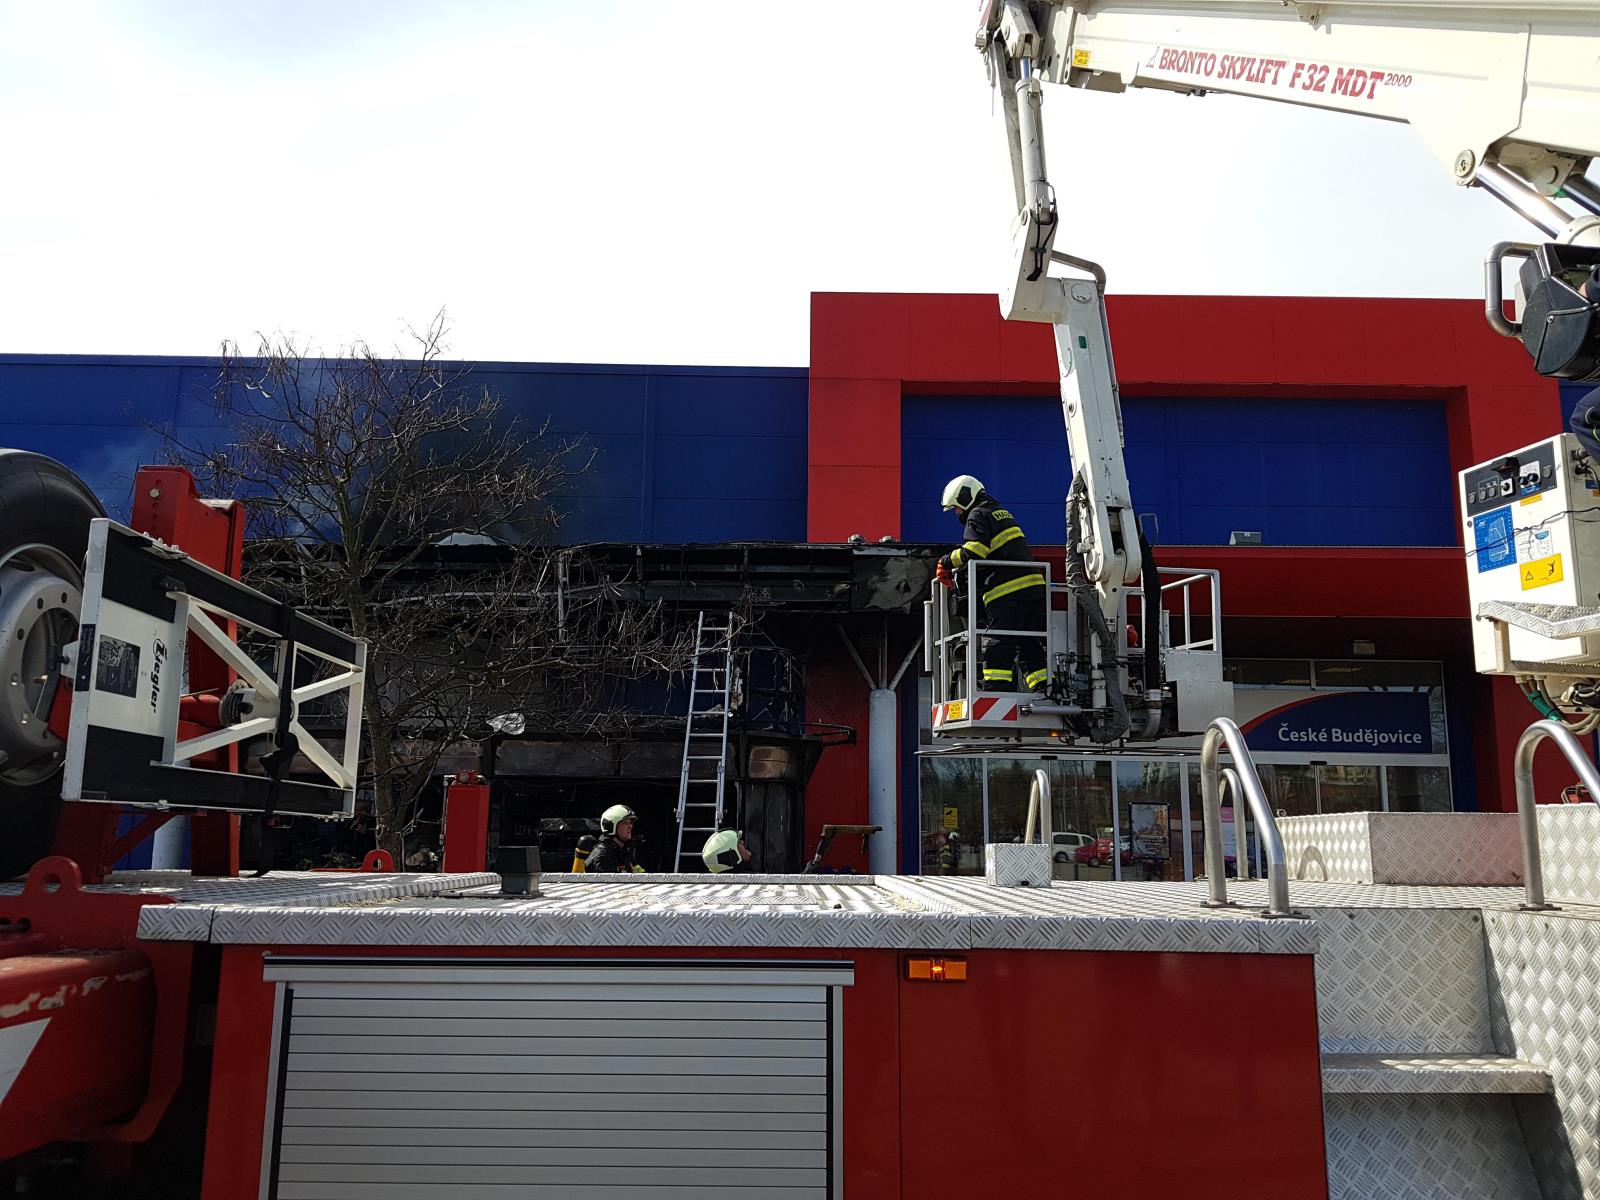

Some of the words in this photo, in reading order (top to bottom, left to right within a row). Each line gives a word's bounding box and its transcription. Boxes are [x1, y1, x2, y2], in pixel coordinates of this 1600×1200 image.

[1158, 48, 1217, 77] BRONTO
[1217, 54, 1287, 85] SKYLIFT
[1331, 67, 1385, 100] MDT
[1384, 73, 1413, 88] 2000
[150, 638, 168, 713] Ziegler
[1278, 722, 1328, 742] České
[1331, 728, 1422, 746] Budějovice
